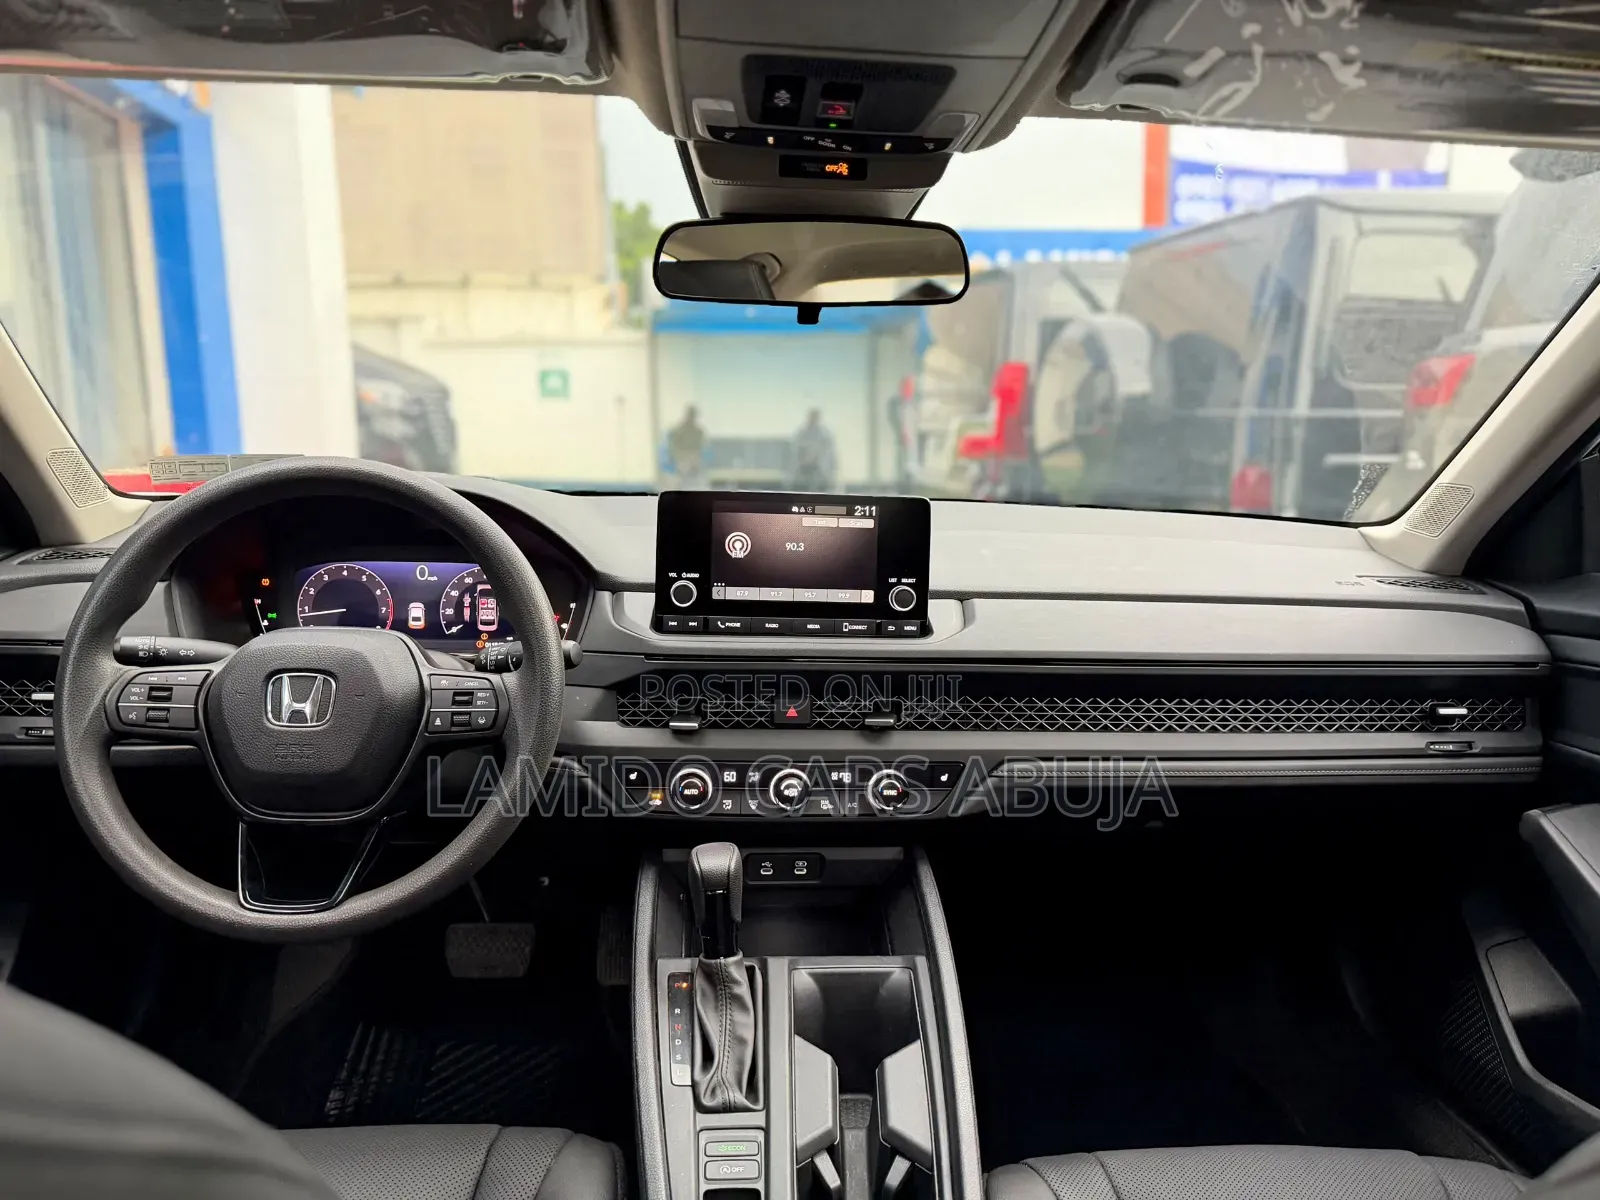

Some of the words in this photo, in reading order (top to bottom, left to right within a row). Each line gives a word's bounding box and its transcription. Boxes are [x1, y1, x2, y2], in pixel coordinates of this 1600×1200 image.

[818, 140, 836, 148] DOOR
[854, 505, 876, 516] 2:11
[785, 542, 805, 551] 90.3
[731, 550, 744, 558] FM
[416, 564, 428, 580] 0
[724, 772, 736, 782] 60
